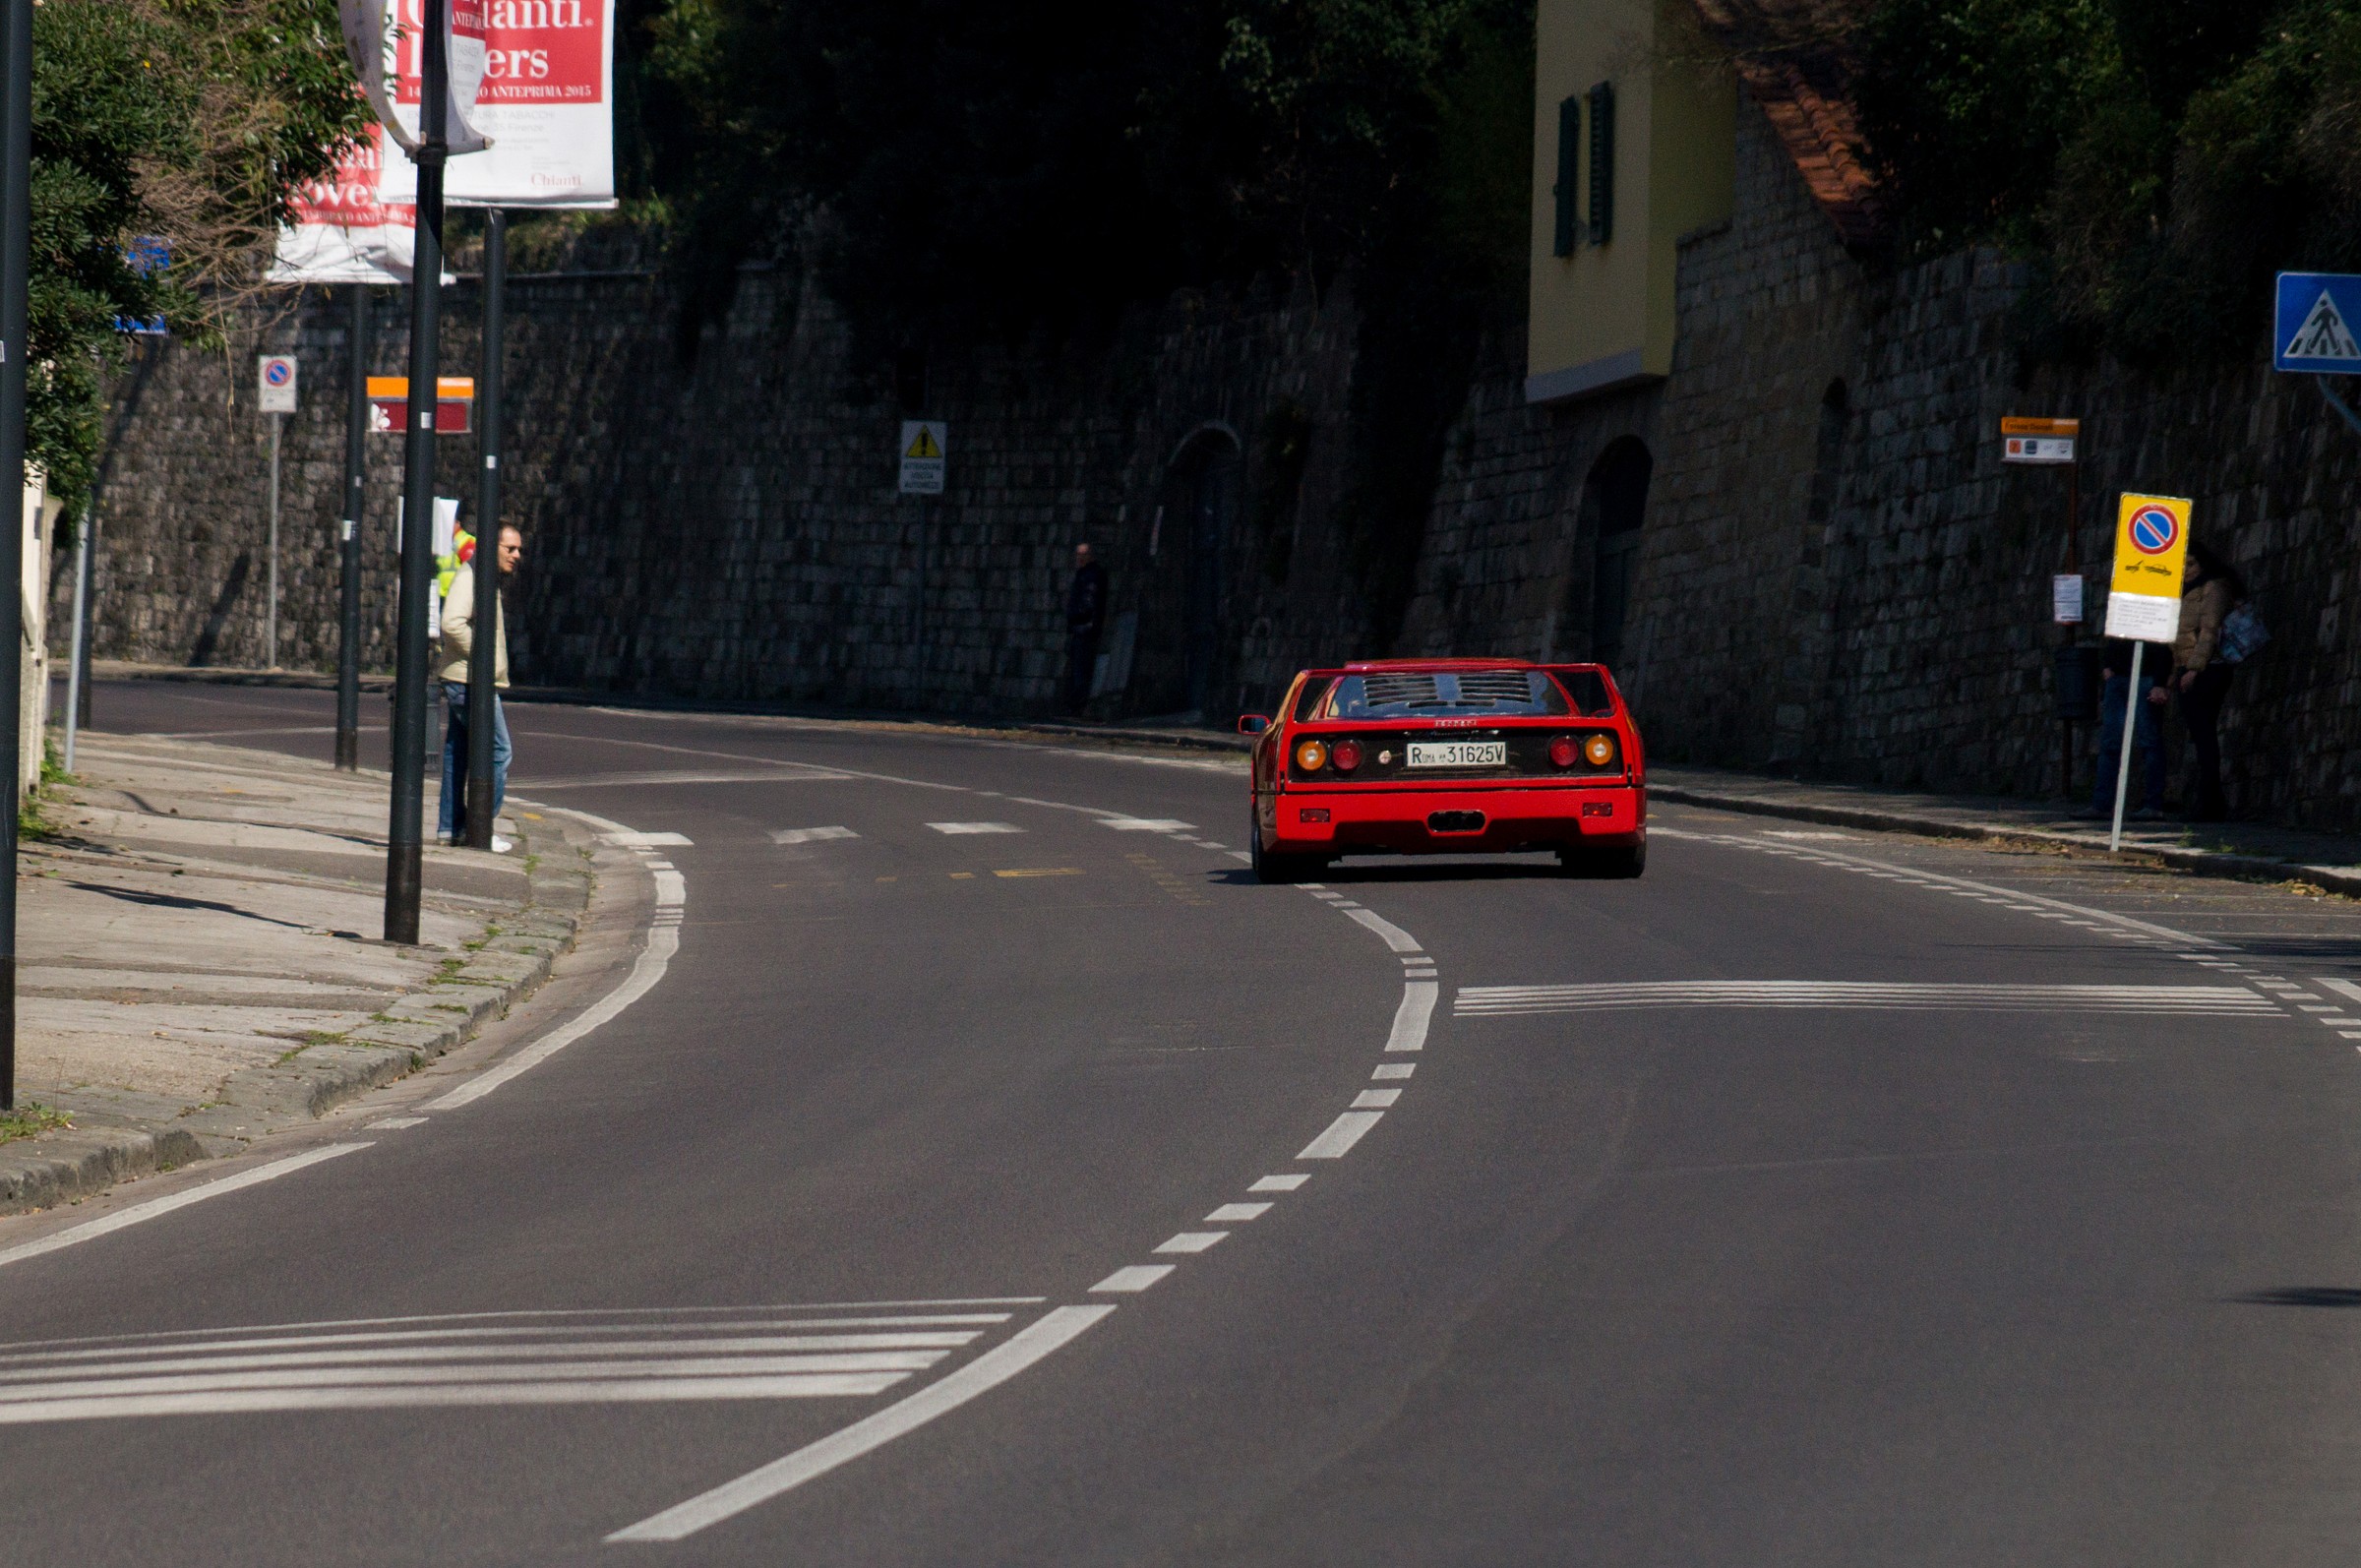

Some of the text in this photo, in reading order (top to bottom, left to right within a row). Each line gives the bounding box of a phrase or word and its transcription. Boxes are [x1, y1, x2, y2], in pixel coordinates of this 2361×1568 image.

[407, 31, 549, 78] lers
[493, 86, 562, 97] ANTEPRIMA
[565, 86, 591, 96] 2015
[503, 110, 555, 119] TABACCHI
[530, 172, 581, 187] Chianti
[1447, 746, 1503, 762] 31625V
